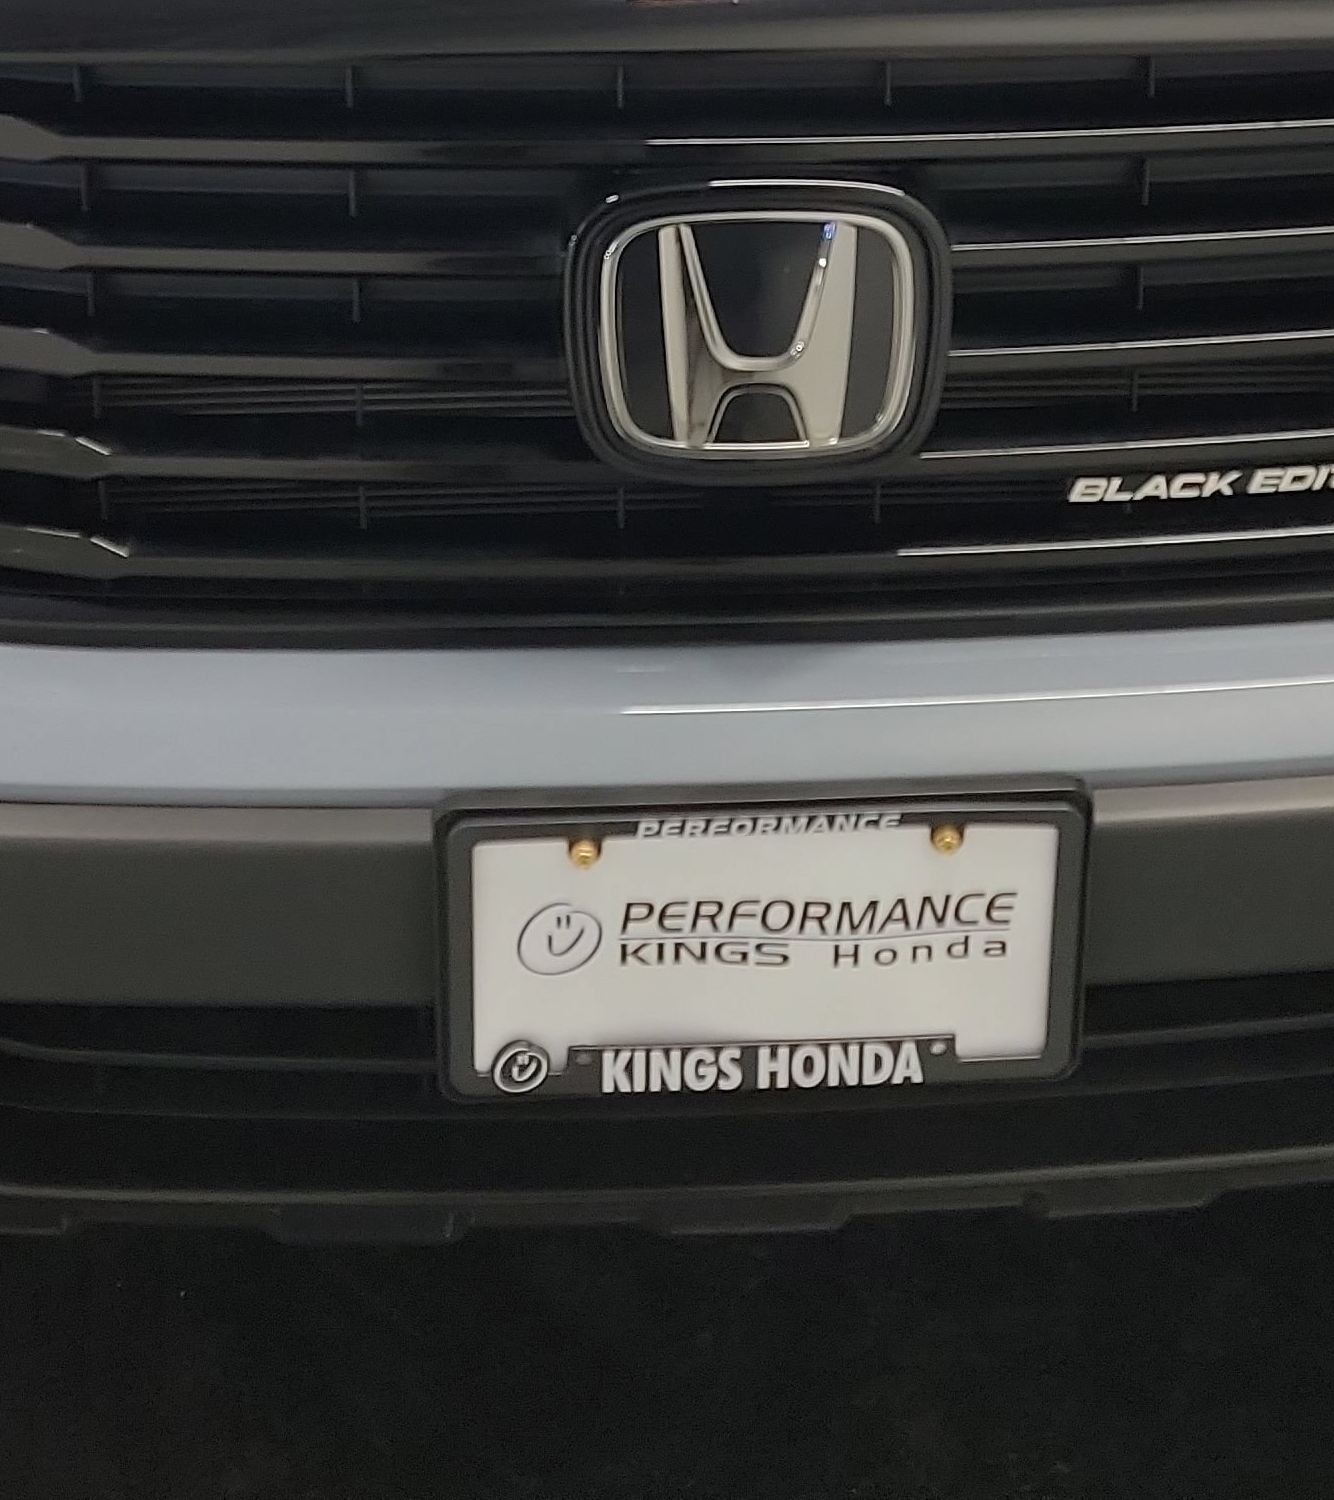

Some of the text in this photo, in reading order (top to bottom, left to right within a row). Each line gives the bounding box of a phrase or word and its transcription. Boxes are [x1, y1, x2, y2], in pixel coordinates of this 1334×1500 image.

[1068, 469, 1244, 503] BLACK
[635, 812, 903, 839] PERFORMANCE
[619, 891, 1017, 935] PERFORMANCE
[618, 935, 1009, 970] KINGS Honda
[600, 1041, 925, 1094] KINGS HONDA
